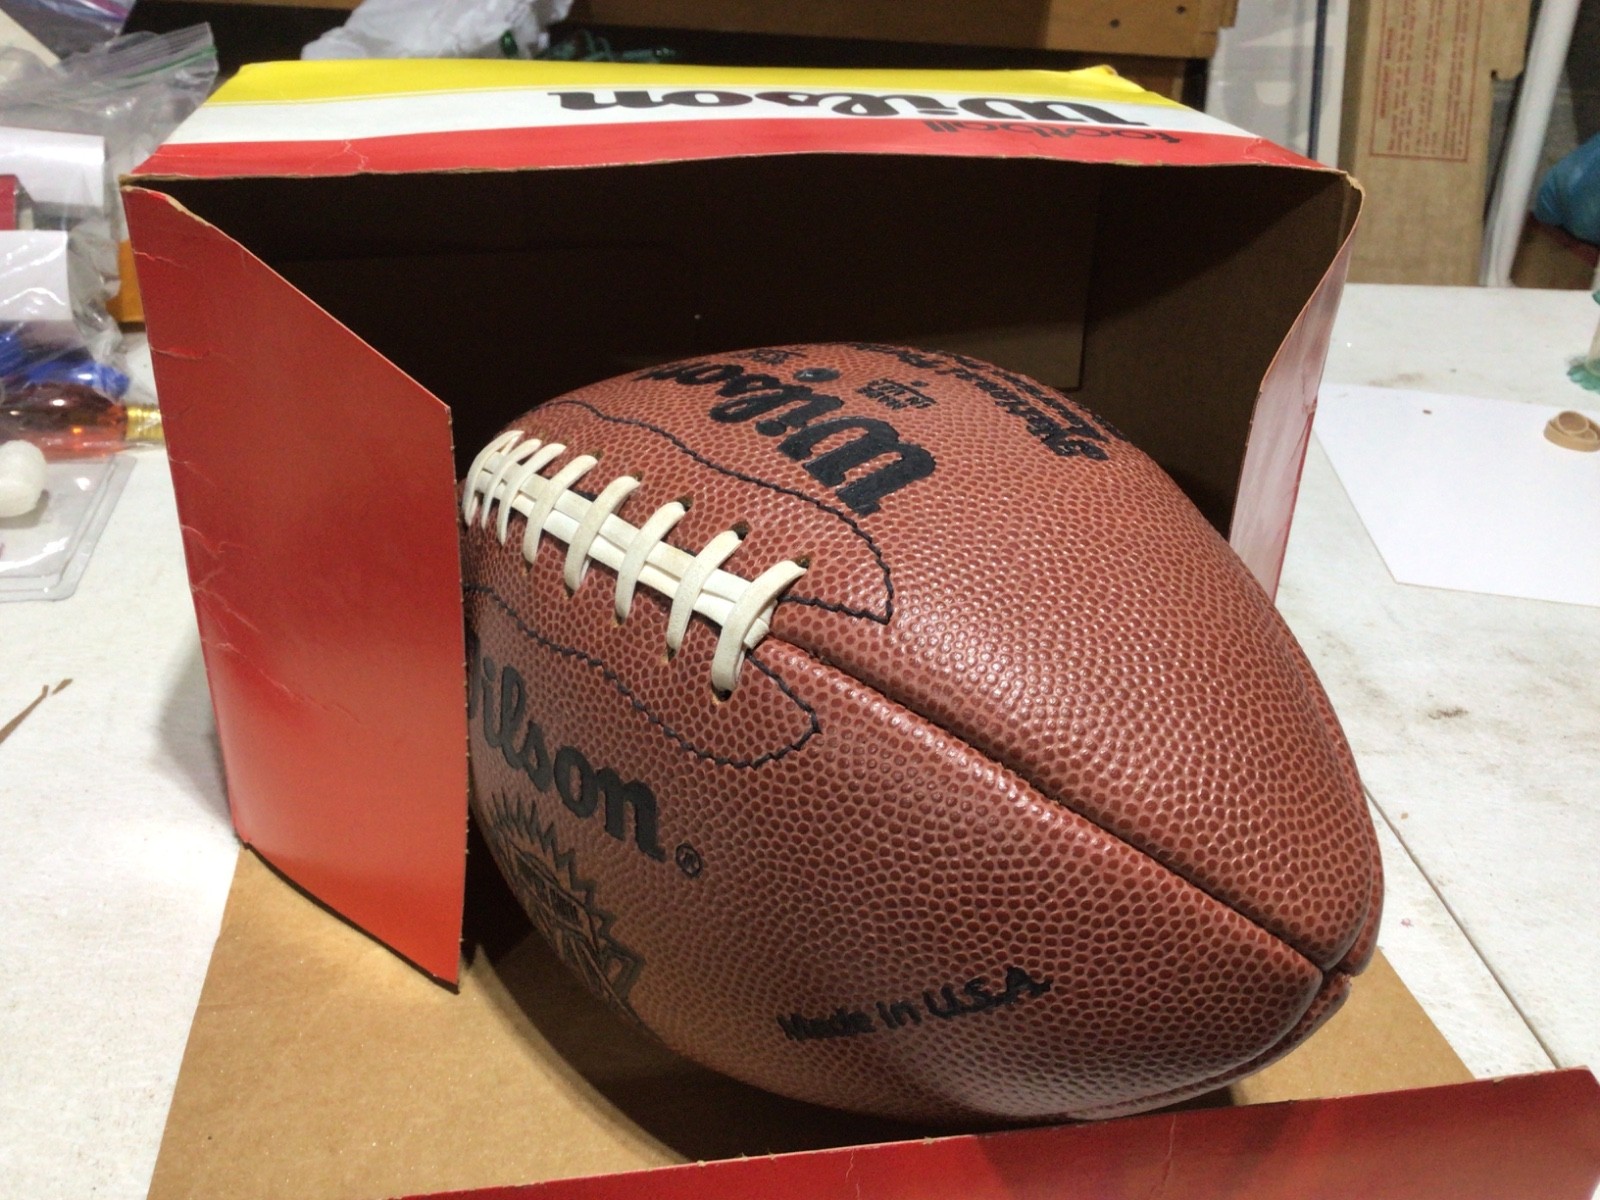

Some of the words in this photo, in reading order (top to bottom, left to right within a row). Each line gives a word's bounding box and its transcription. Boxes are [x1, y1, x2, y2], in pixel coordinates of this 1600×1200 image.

[546, 89, 1151, 127] Wilson
[923, 119, 1182, 144] football
[632, 360, 937, 518] Wilson
[466, 632, 667, 863] ilson
